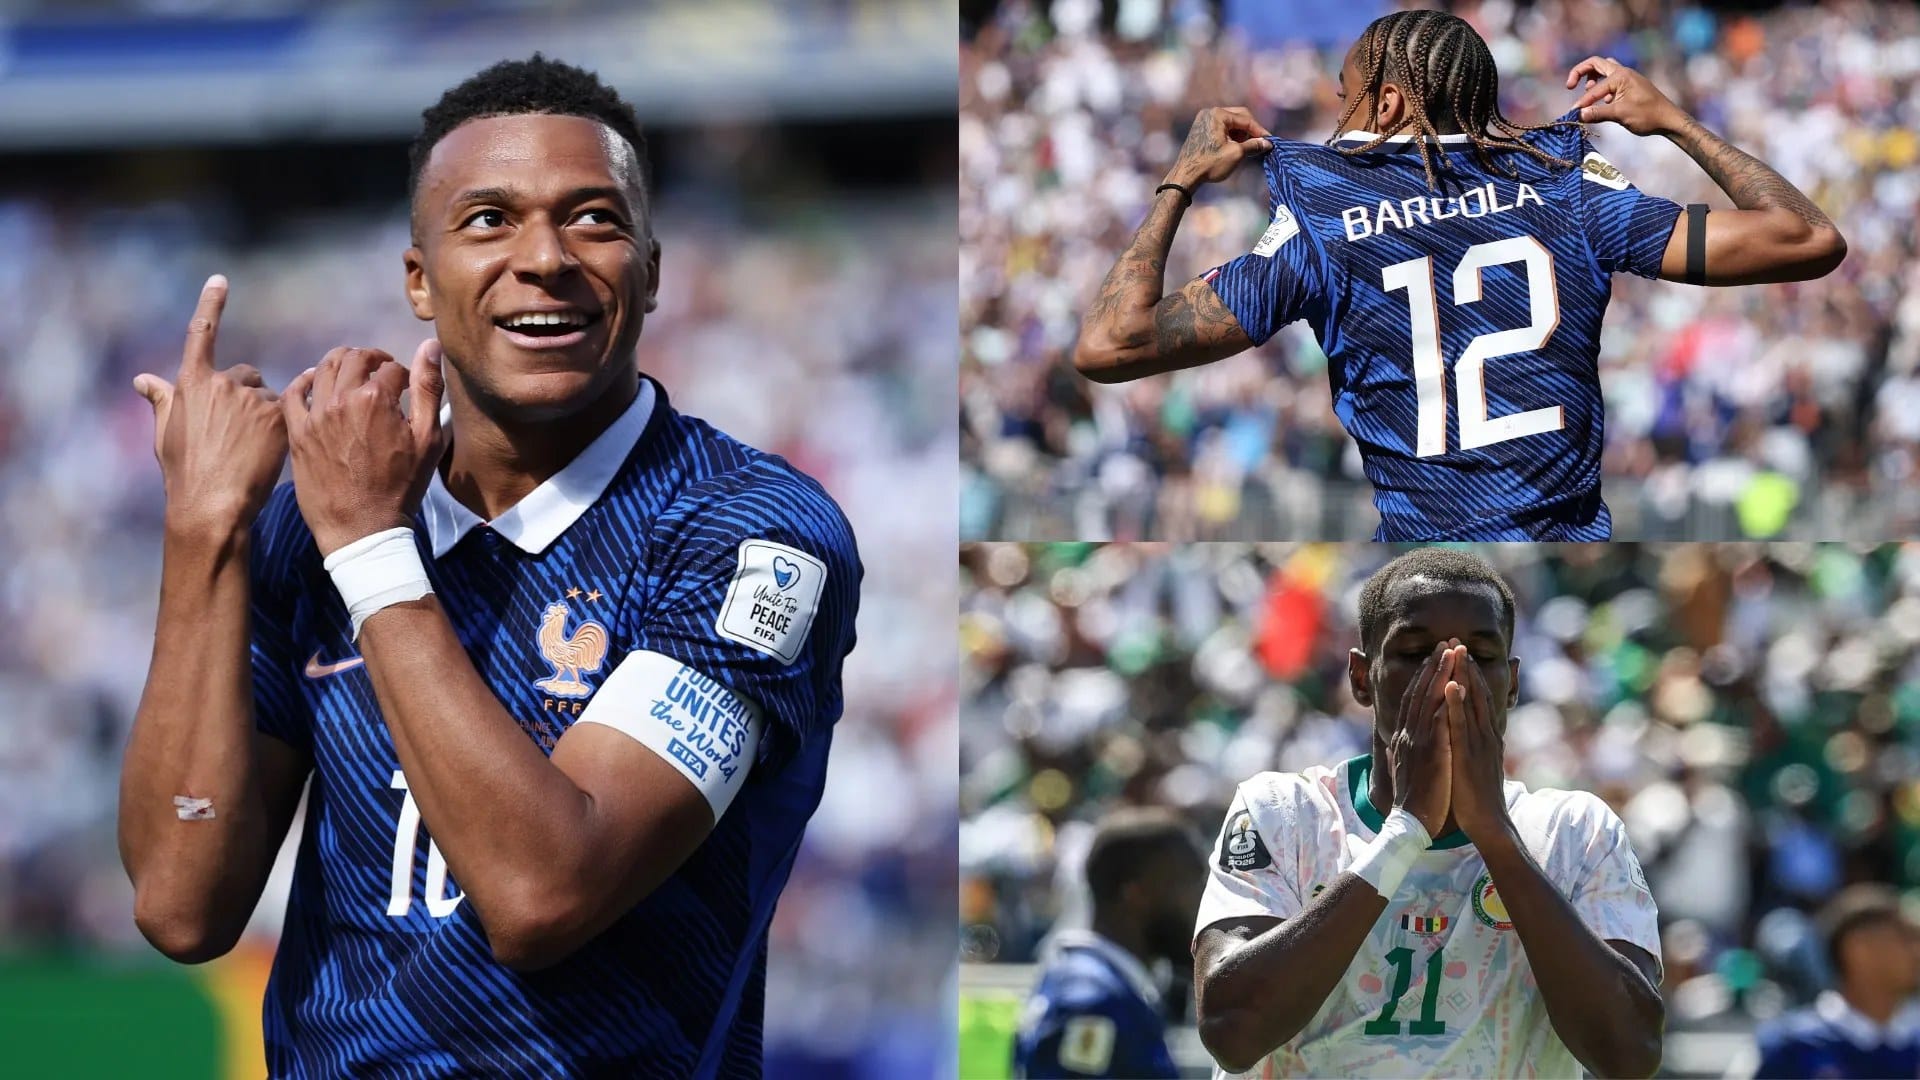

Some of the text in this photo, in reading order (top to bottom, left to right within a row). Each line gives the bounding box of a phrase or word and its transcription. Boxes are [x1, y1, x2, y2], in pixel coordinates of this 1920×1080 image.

[1341, 183, 1545, 242] BARCOLA
[1381, 235, 1565, 458] 12
[750, 603, 791, 635] PEACE
[753, 585, 798, 614] Unite For
[753, 626, 775, 642] FIFA
[650, 699, 738, 784] the World
[665, 676, 746, 757] UNITES
[670, 741, 703, 775] FIFA
[1364, 946, 1446, 1035] 11
